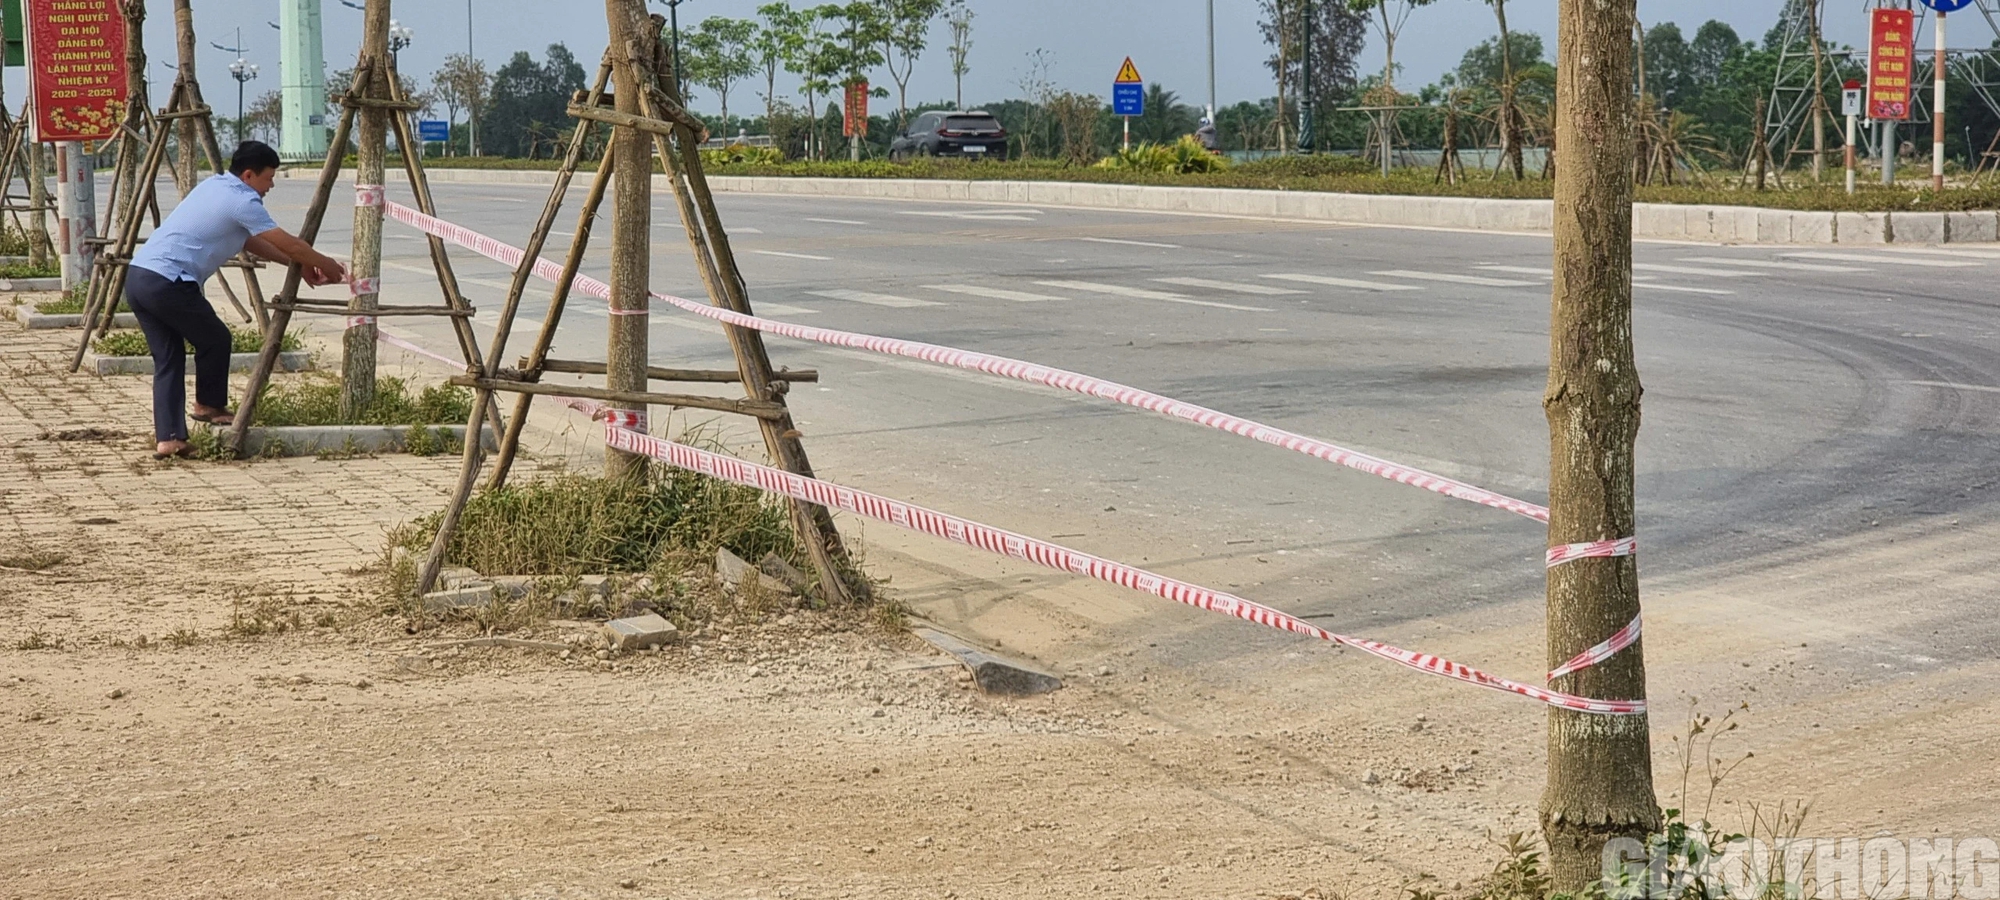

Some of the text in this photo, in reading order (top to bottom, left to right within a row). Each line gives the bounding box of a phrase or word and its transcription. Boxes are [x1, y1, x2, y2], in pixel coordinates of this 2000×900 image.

[89, 1, 105, 11] LỢI
[48, 12, 109, 24] NGHỊ QUYẾT
[61, 25, 100, 37] ĐẠI HỘI
[57, 38, 104, 49] ĐẢNG BỘ
[52, 49, 111, 60] THÀNH PHỐ
[58, 76, 93, 86] NHIỆM
[51, 90, 77, 99] 2020
[87, 88, 117, 98] 2025!
